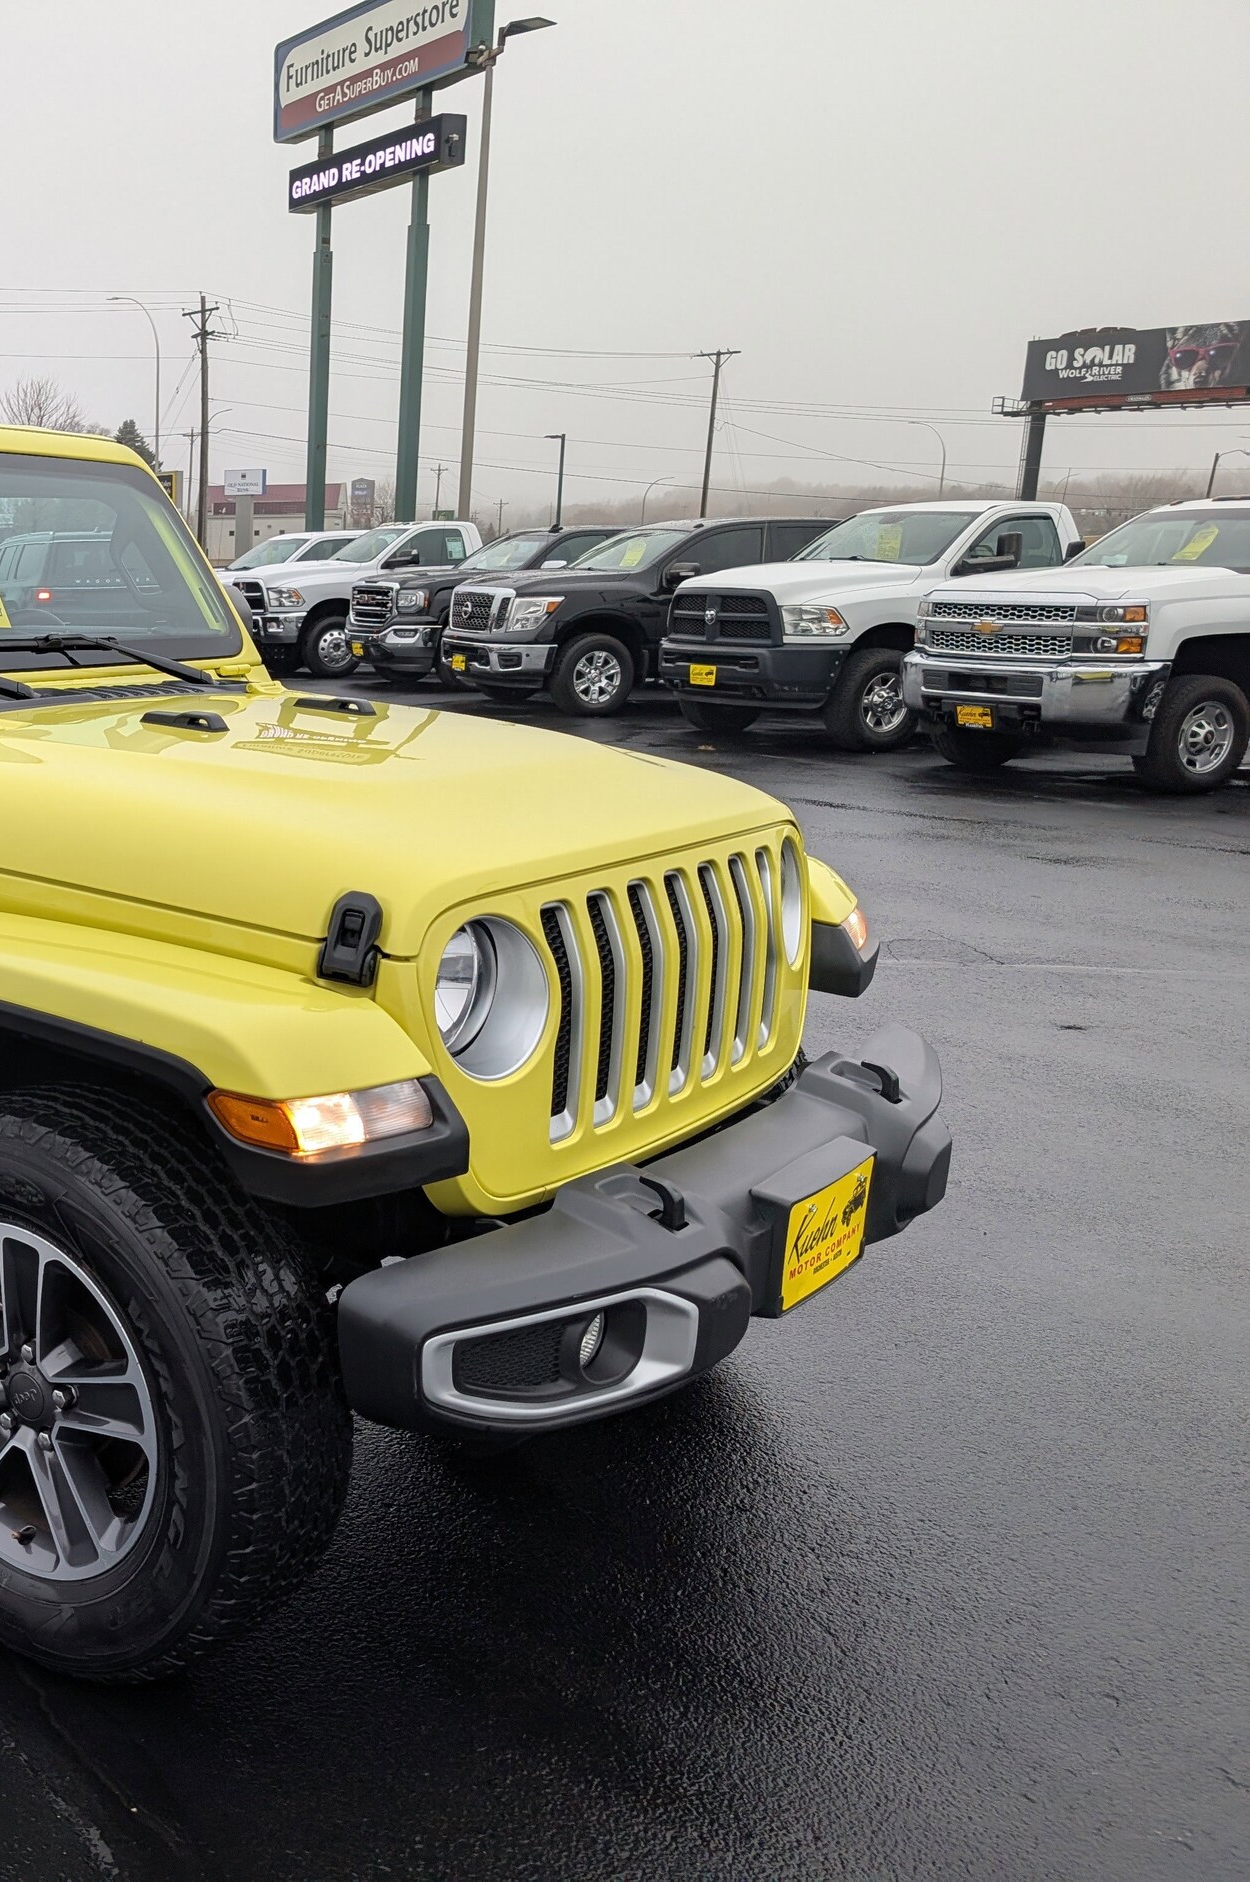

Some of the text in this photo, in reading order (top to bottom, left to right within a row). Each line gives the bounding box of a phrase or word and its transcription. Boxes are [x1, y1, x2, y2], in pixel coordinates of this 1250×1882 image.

[286, 0, 459, 94] Furniture Superstore
[292, 132, 436, 199] GRAND RE-OPENING
[1045, 343, 1136, 370] GO SOLAR
[1058, 366, 1123, 378] WOLF RIVER
[788, 1197, 838, 1265] Kuehn
[788, 1222, 861, 1281] MOTOR COMPANY
